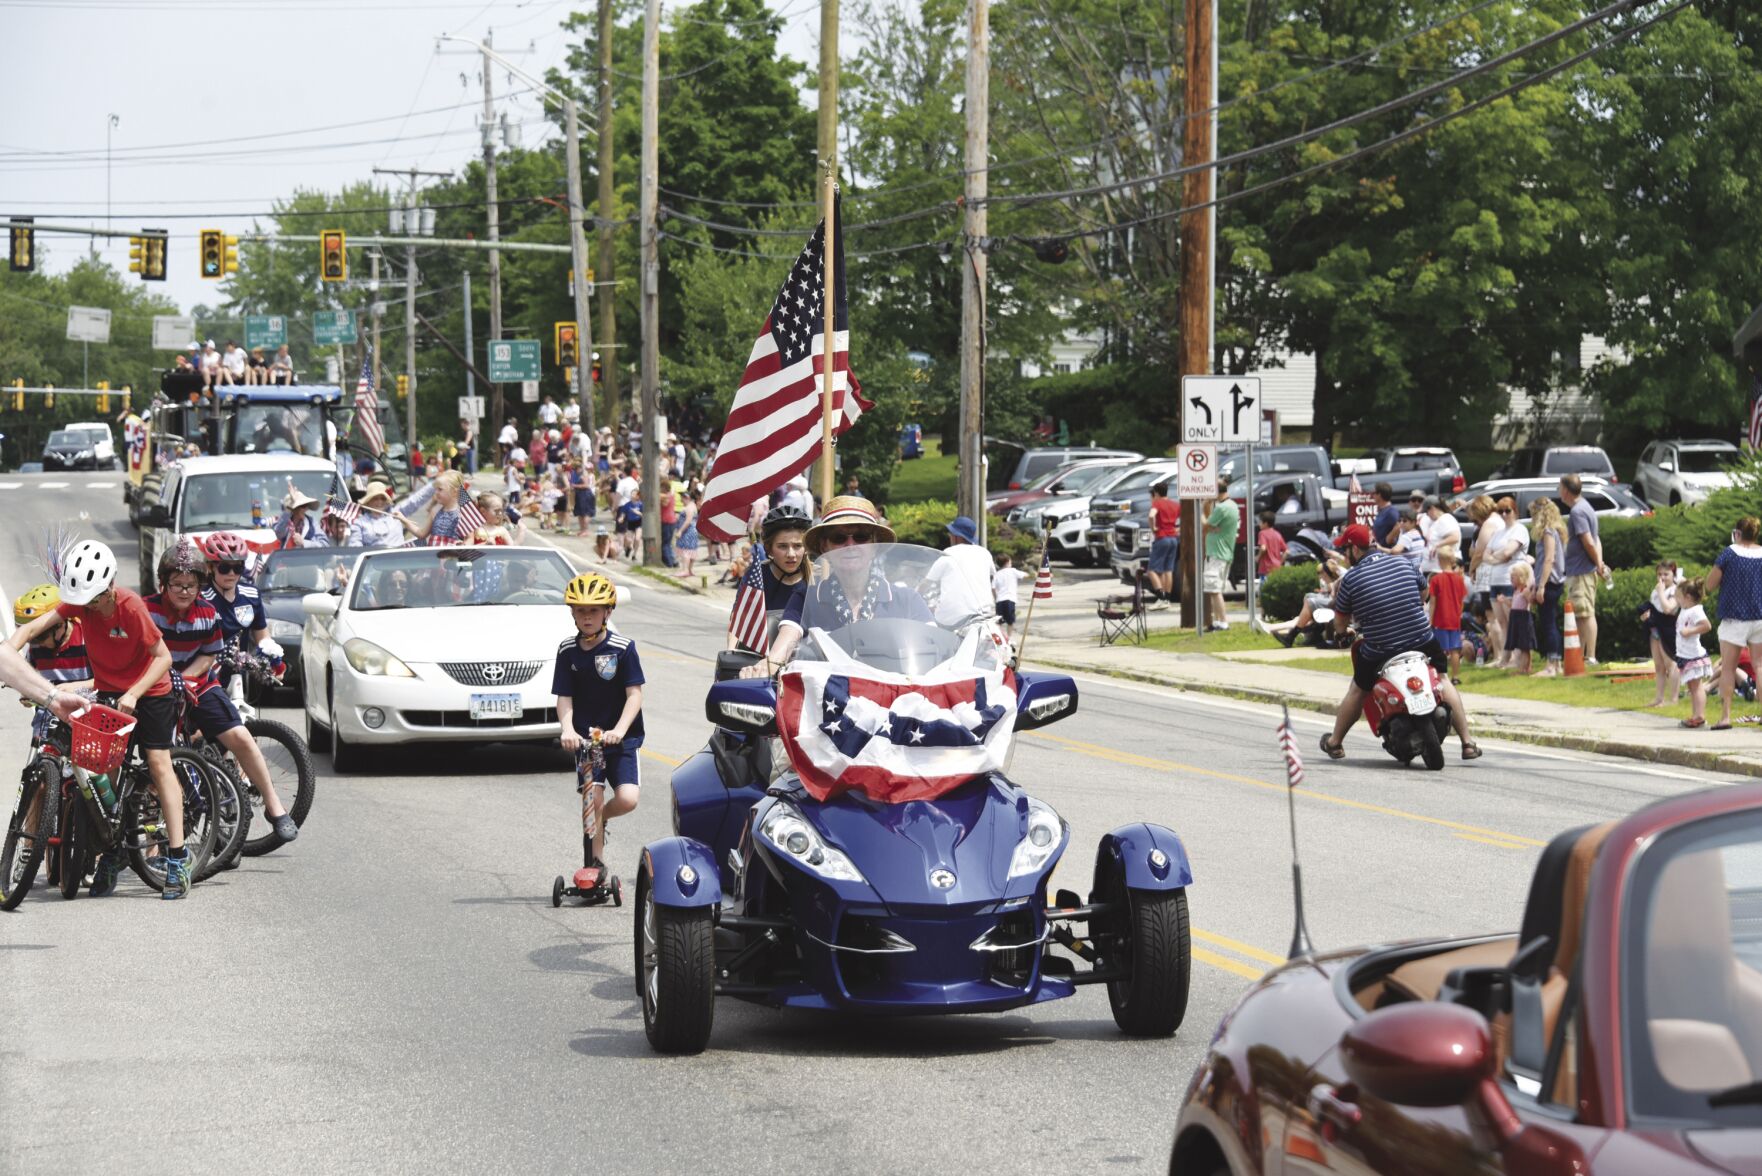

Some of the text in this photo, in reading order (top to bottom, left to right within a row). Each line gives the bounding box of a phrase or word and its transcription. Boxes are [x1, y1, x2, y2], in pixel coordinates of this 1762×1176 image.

[497, 347, 510, 358] 153
[1188, 427, 1217, 438] ONLY
[1191, 475, 1203, 483] NO
[1180, 485, 1214, 493] PARKING
[1355, 504, 1379, 516] ONE
